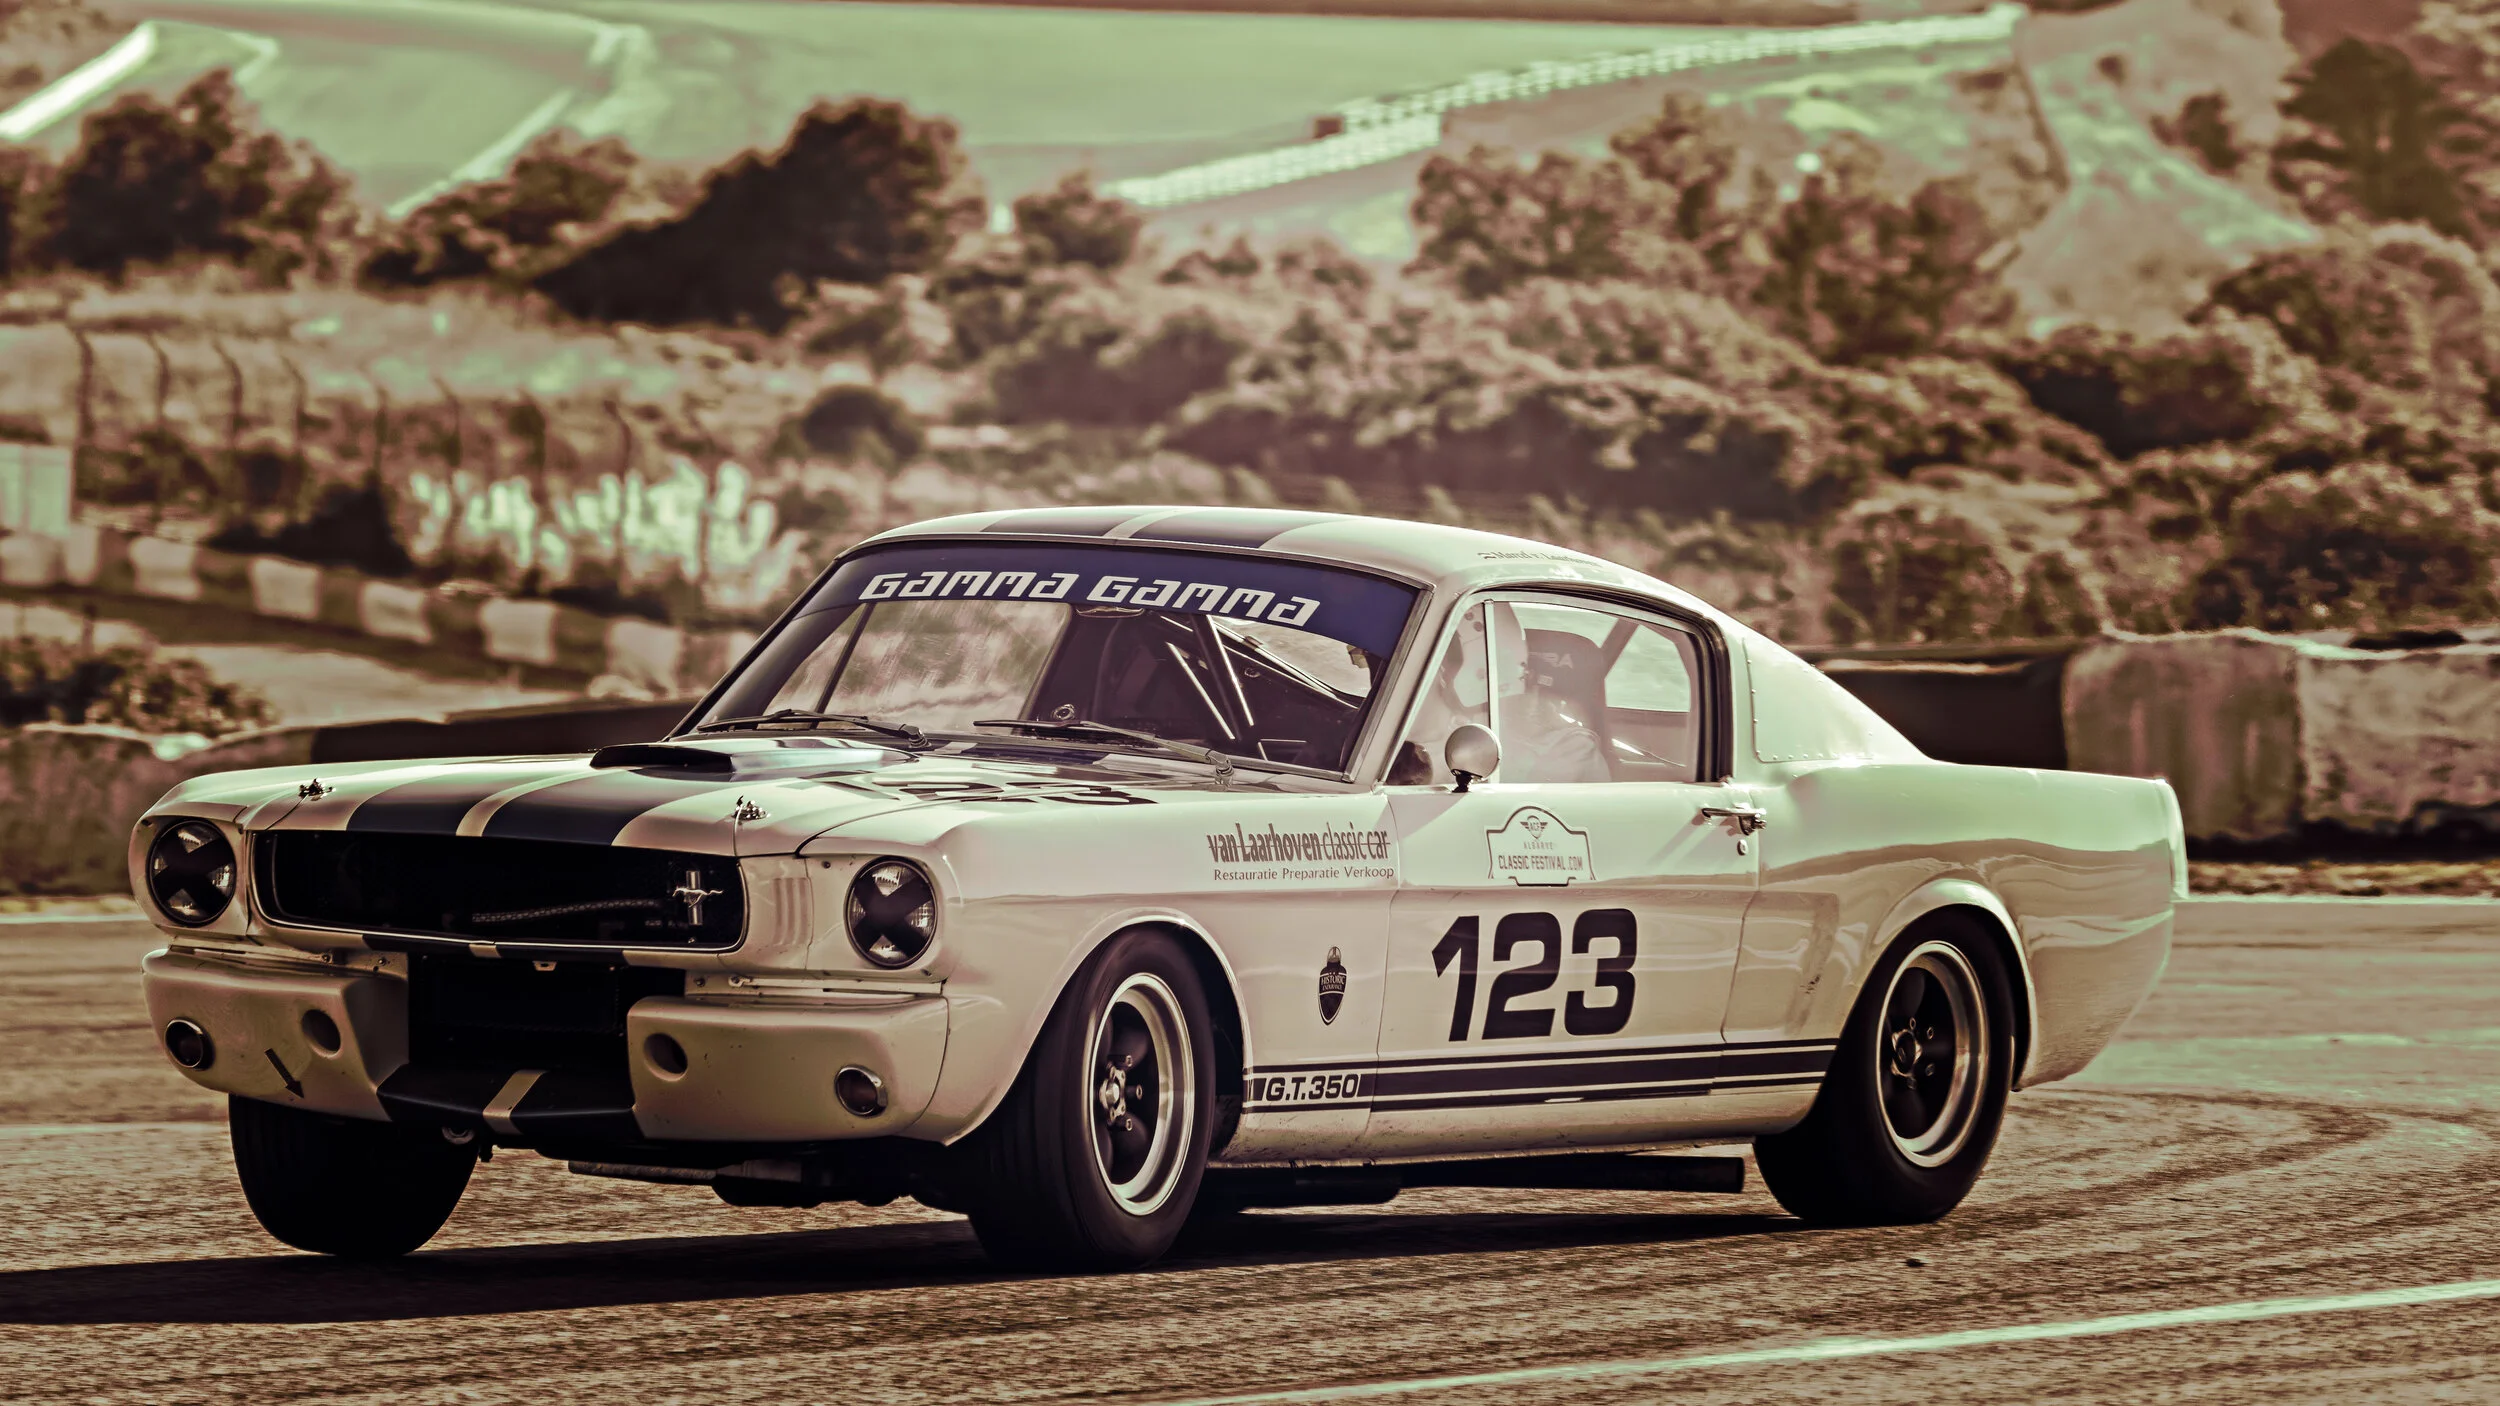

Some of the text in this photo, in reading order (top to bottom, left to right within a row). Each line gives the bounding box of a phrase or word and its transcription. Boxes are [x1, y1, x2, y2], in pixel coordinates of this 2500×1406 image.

[1322, 821, 1367, 861] classic
[1367, 829, 1389, 860] car
[1214, 866, 1395, 881] Restauratie Preparatie Verkoop
[1498, 855, 1530, 870] CLASSIC
[1531, 855, 1566, 870] FESTIVAL
[1432, 908, 1637, 1042] 123
[1265, 1073, 1359, 1101] G.T.350
